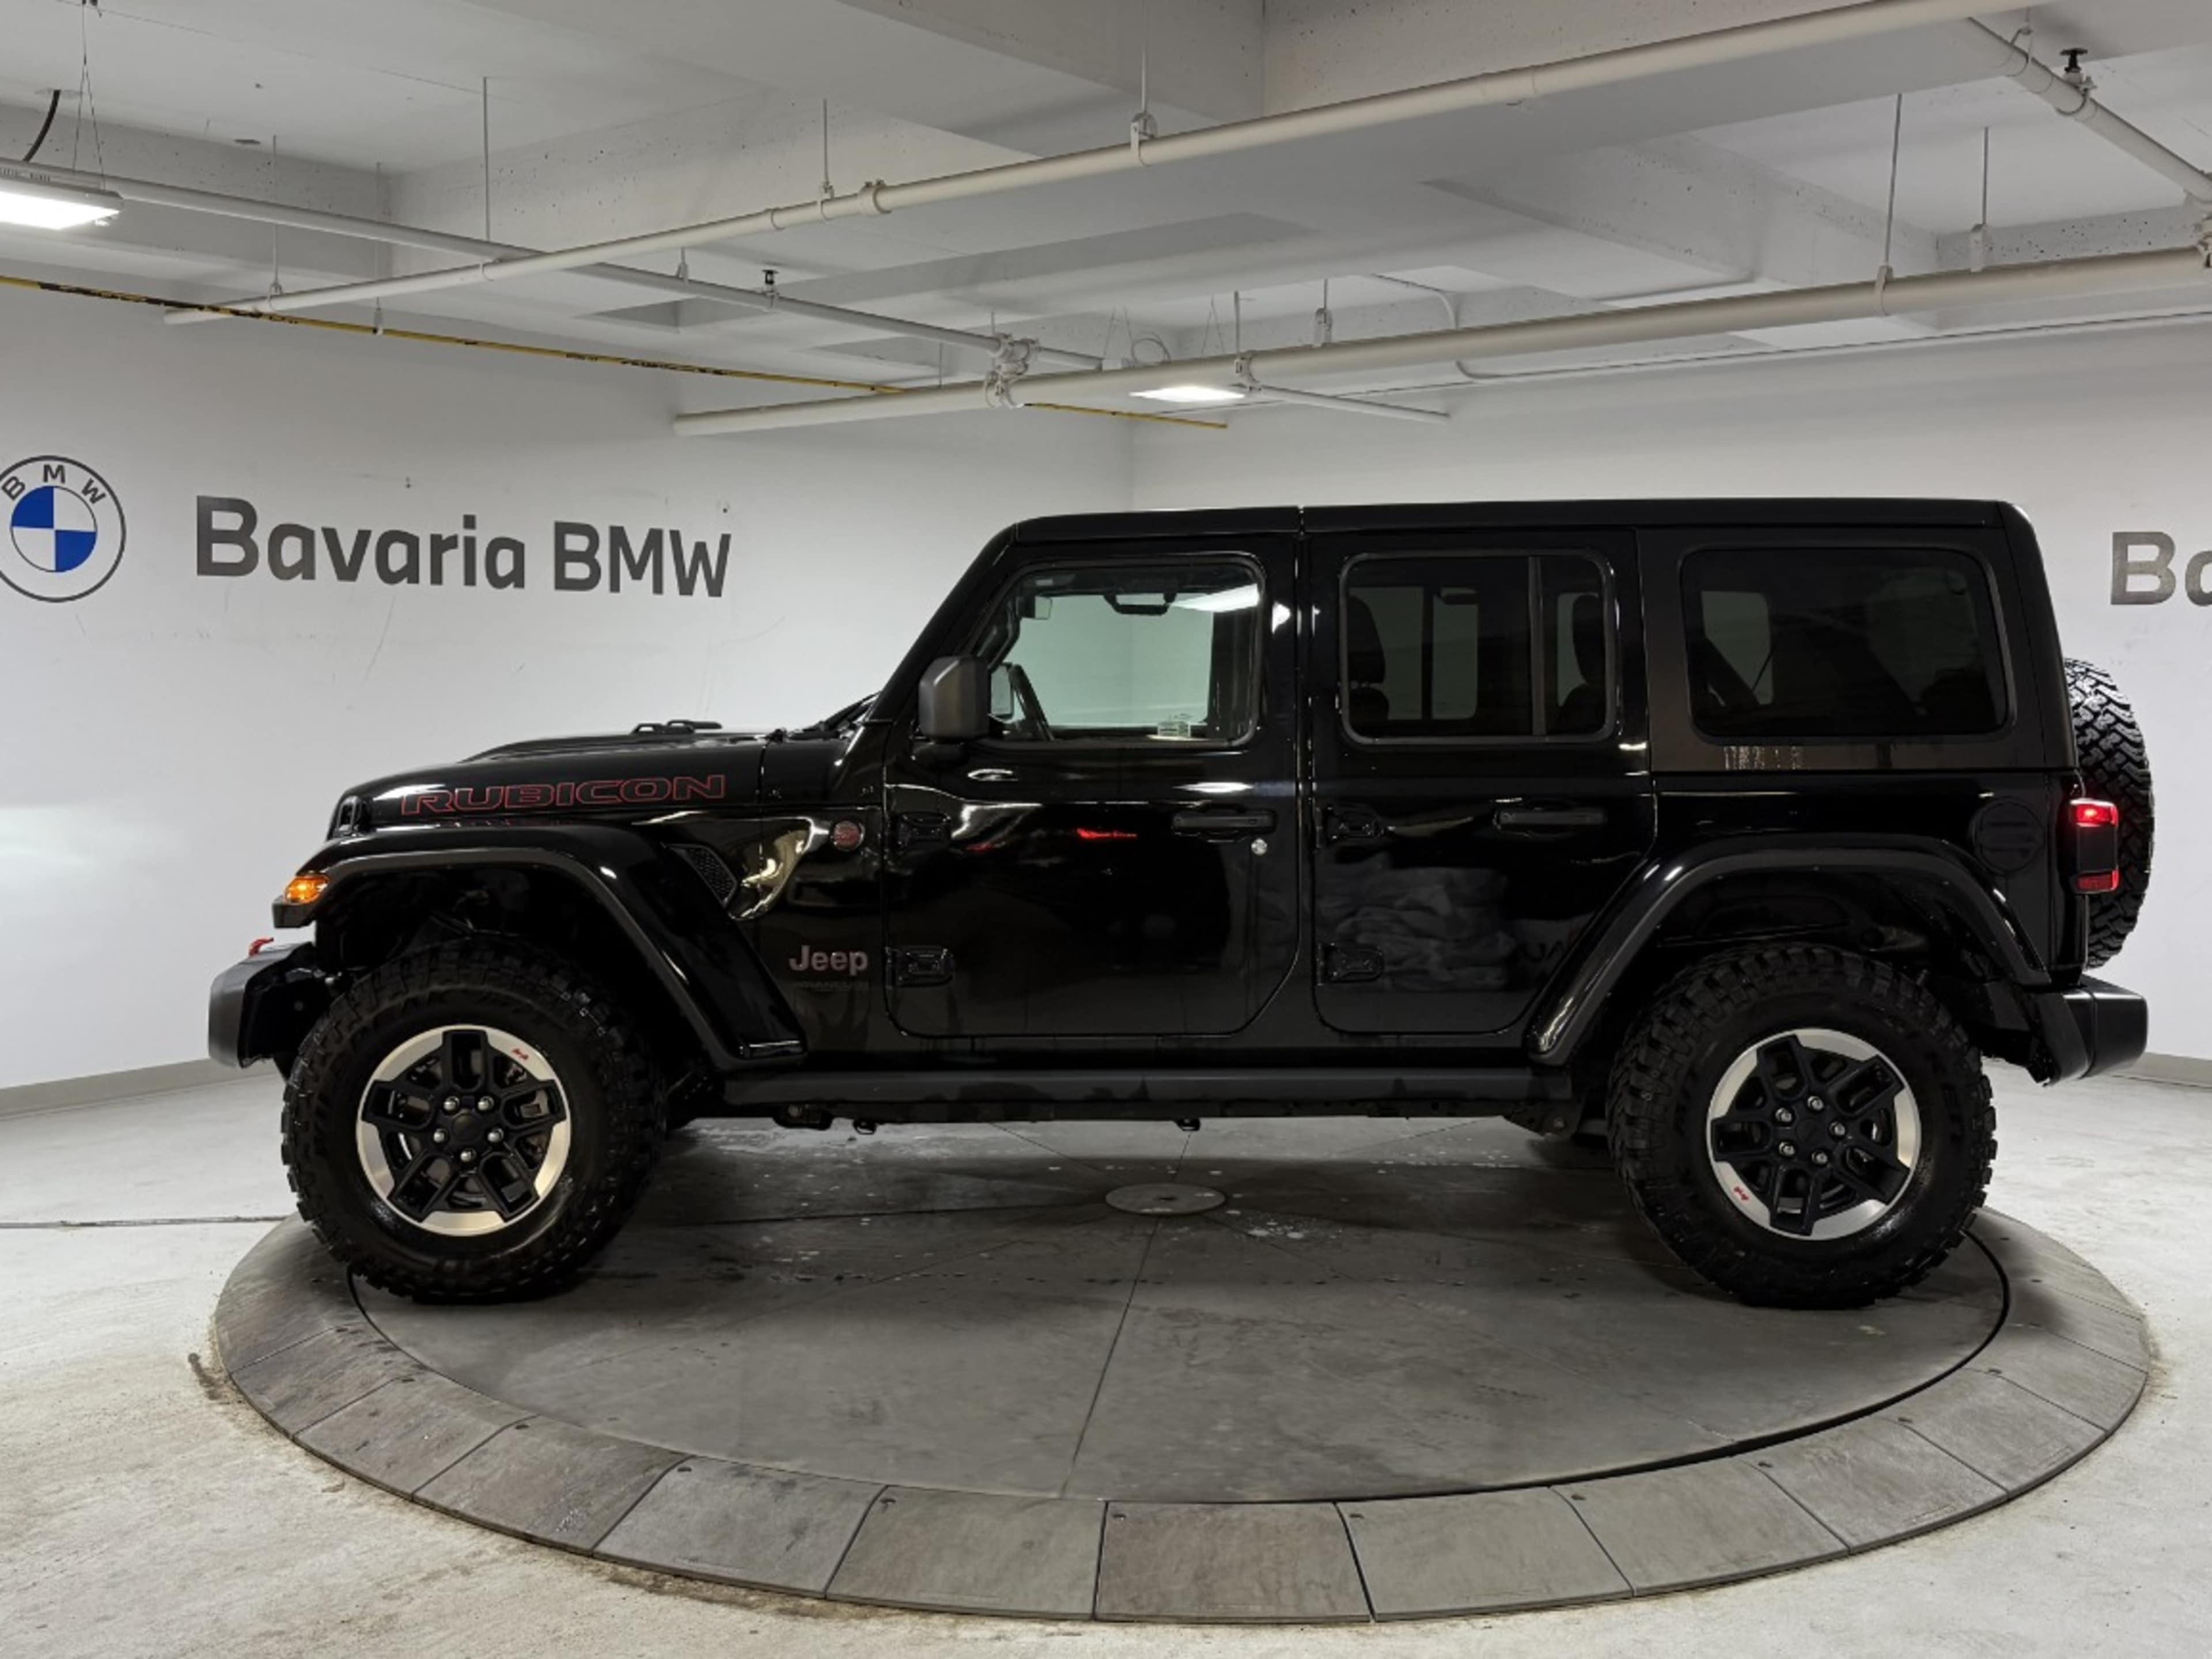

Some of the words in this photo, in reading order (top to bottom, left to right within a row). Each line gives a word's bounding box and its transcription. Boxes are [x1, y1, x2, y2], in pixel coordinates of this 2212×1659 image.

[2, 464, 106, 505] BMW
[196, 495, 525, 589] Bavaria
[554, 520, 732, 597] BMW
[402, 774, 725, 816] RUBICON
[788, 945, 868, 975] Jeep
